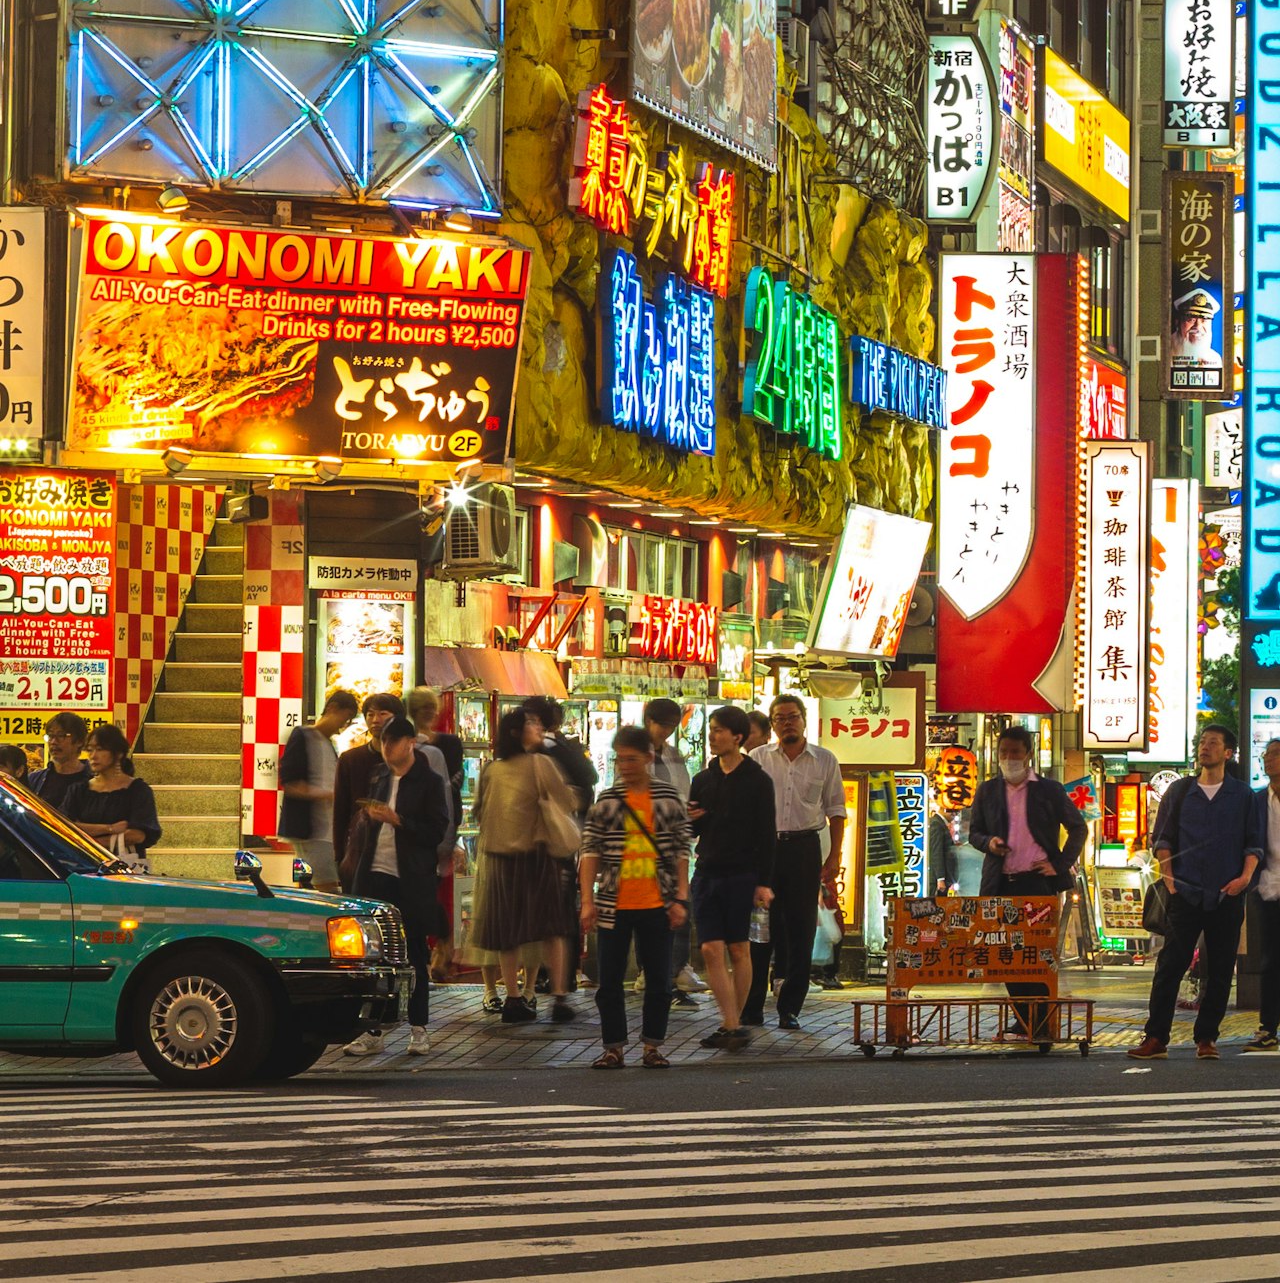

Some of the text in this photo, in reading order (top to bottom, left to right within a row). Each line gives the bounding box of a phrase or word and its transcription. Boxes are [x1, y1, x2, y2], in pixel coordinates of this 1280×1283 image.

[933, 50, 973, 67] 新宿
[933, 69, 974, 174] かっぱ
[935, 185, 970, 207] B1
[1179, 188, 1212, 283] 海の家
[93, 222, 524, 294] OKONOMI YAKI
[92, 278, 518, 326] All-You-Can-Eat dinner with Free-Flowing
[1003, 261, 1030, 381] 大衆酒場
[262, 315, 517, 350] Drinks for 2 hours ¥2,500
[949, 275, 996, 478] トラノコ
[71, 511, 112, 529] YAKI
[317, 565, 412, 581] 防犯カメラ作動中
[341, 591, 366, 599] carte
[4, 638, 91, 648] Flowing Drinks
[42, 628, 66, 638] with
[829, 717, 911, 739] トラノコ
[1104, 716, 1124, 728] 2F
[922, 947, 1038, 968] 歩行者専用
